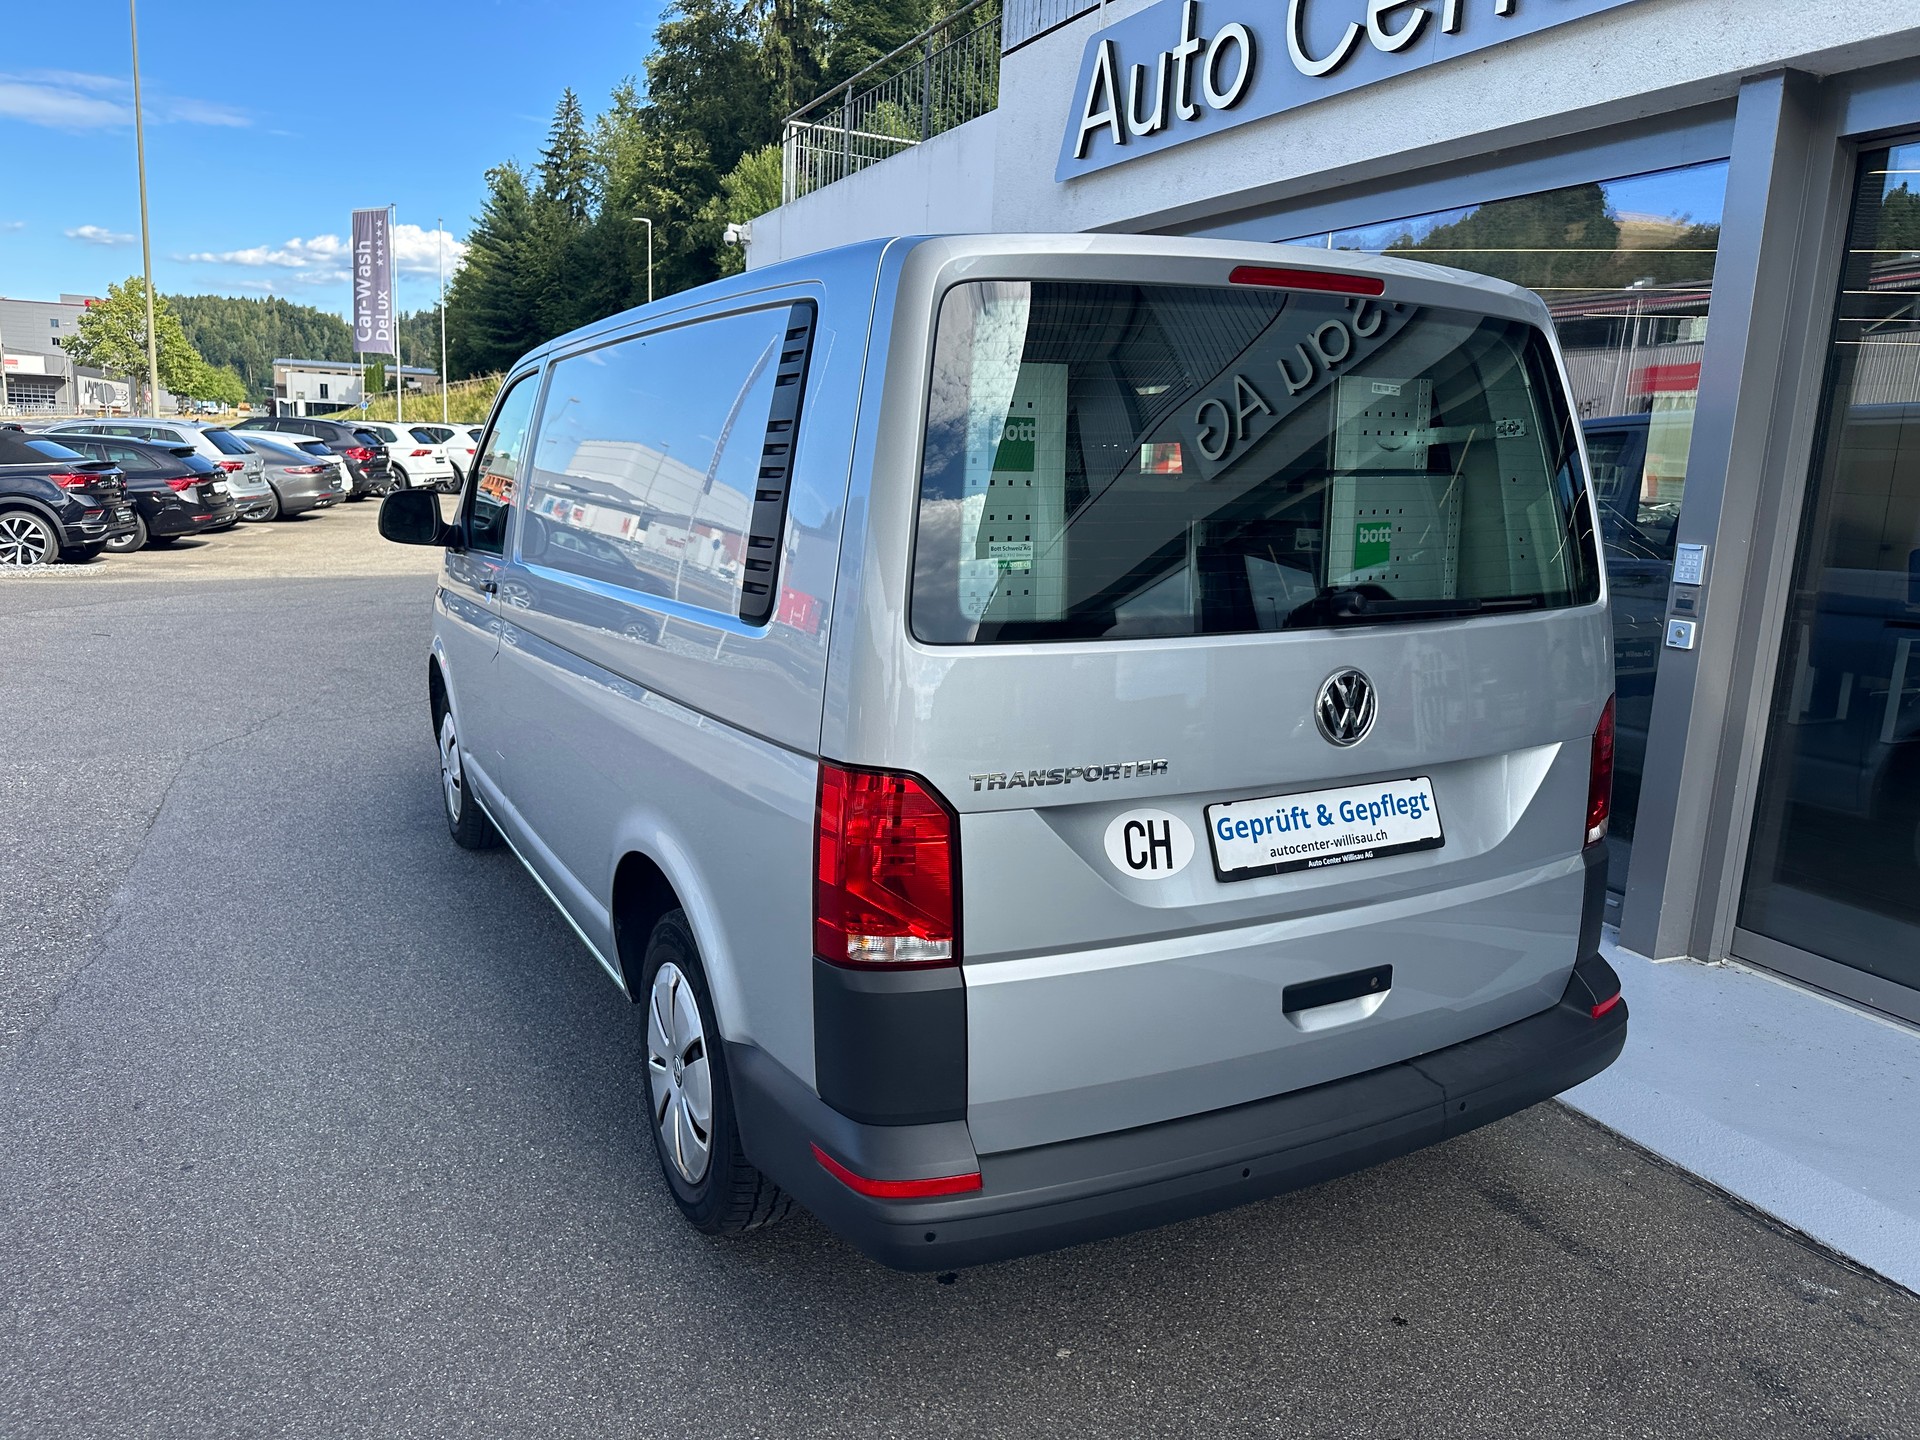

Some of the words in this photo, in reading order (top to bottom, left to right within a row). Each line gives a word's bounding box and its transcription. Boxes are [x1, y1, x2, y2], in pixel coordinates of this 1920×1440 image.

[1073, 0, 1256, 159] Auto
[356, 240, 371, 342] Car-Wash
[375, 290, 388, 341] DeLux
[1359, 526, 1391, 543] bott
[969, 758, 1169, 791] TRANSPORTER
[1216, 806, 1311, 843] Geprüft
[1316, 803, 1335, 826] &
[1339, 792, 1430, 826] Gepflegt
[1123, 819, 1174, 870] CH
[1269, 829, 1388, 858] autocenter-willisau.ch
[1308, 860, 1322, 868] Auto
[1322, 857, 1342, 866] Center
[1342, 853, 1364, 863] Willisau
[1364, 851, 1374, 859] AG
